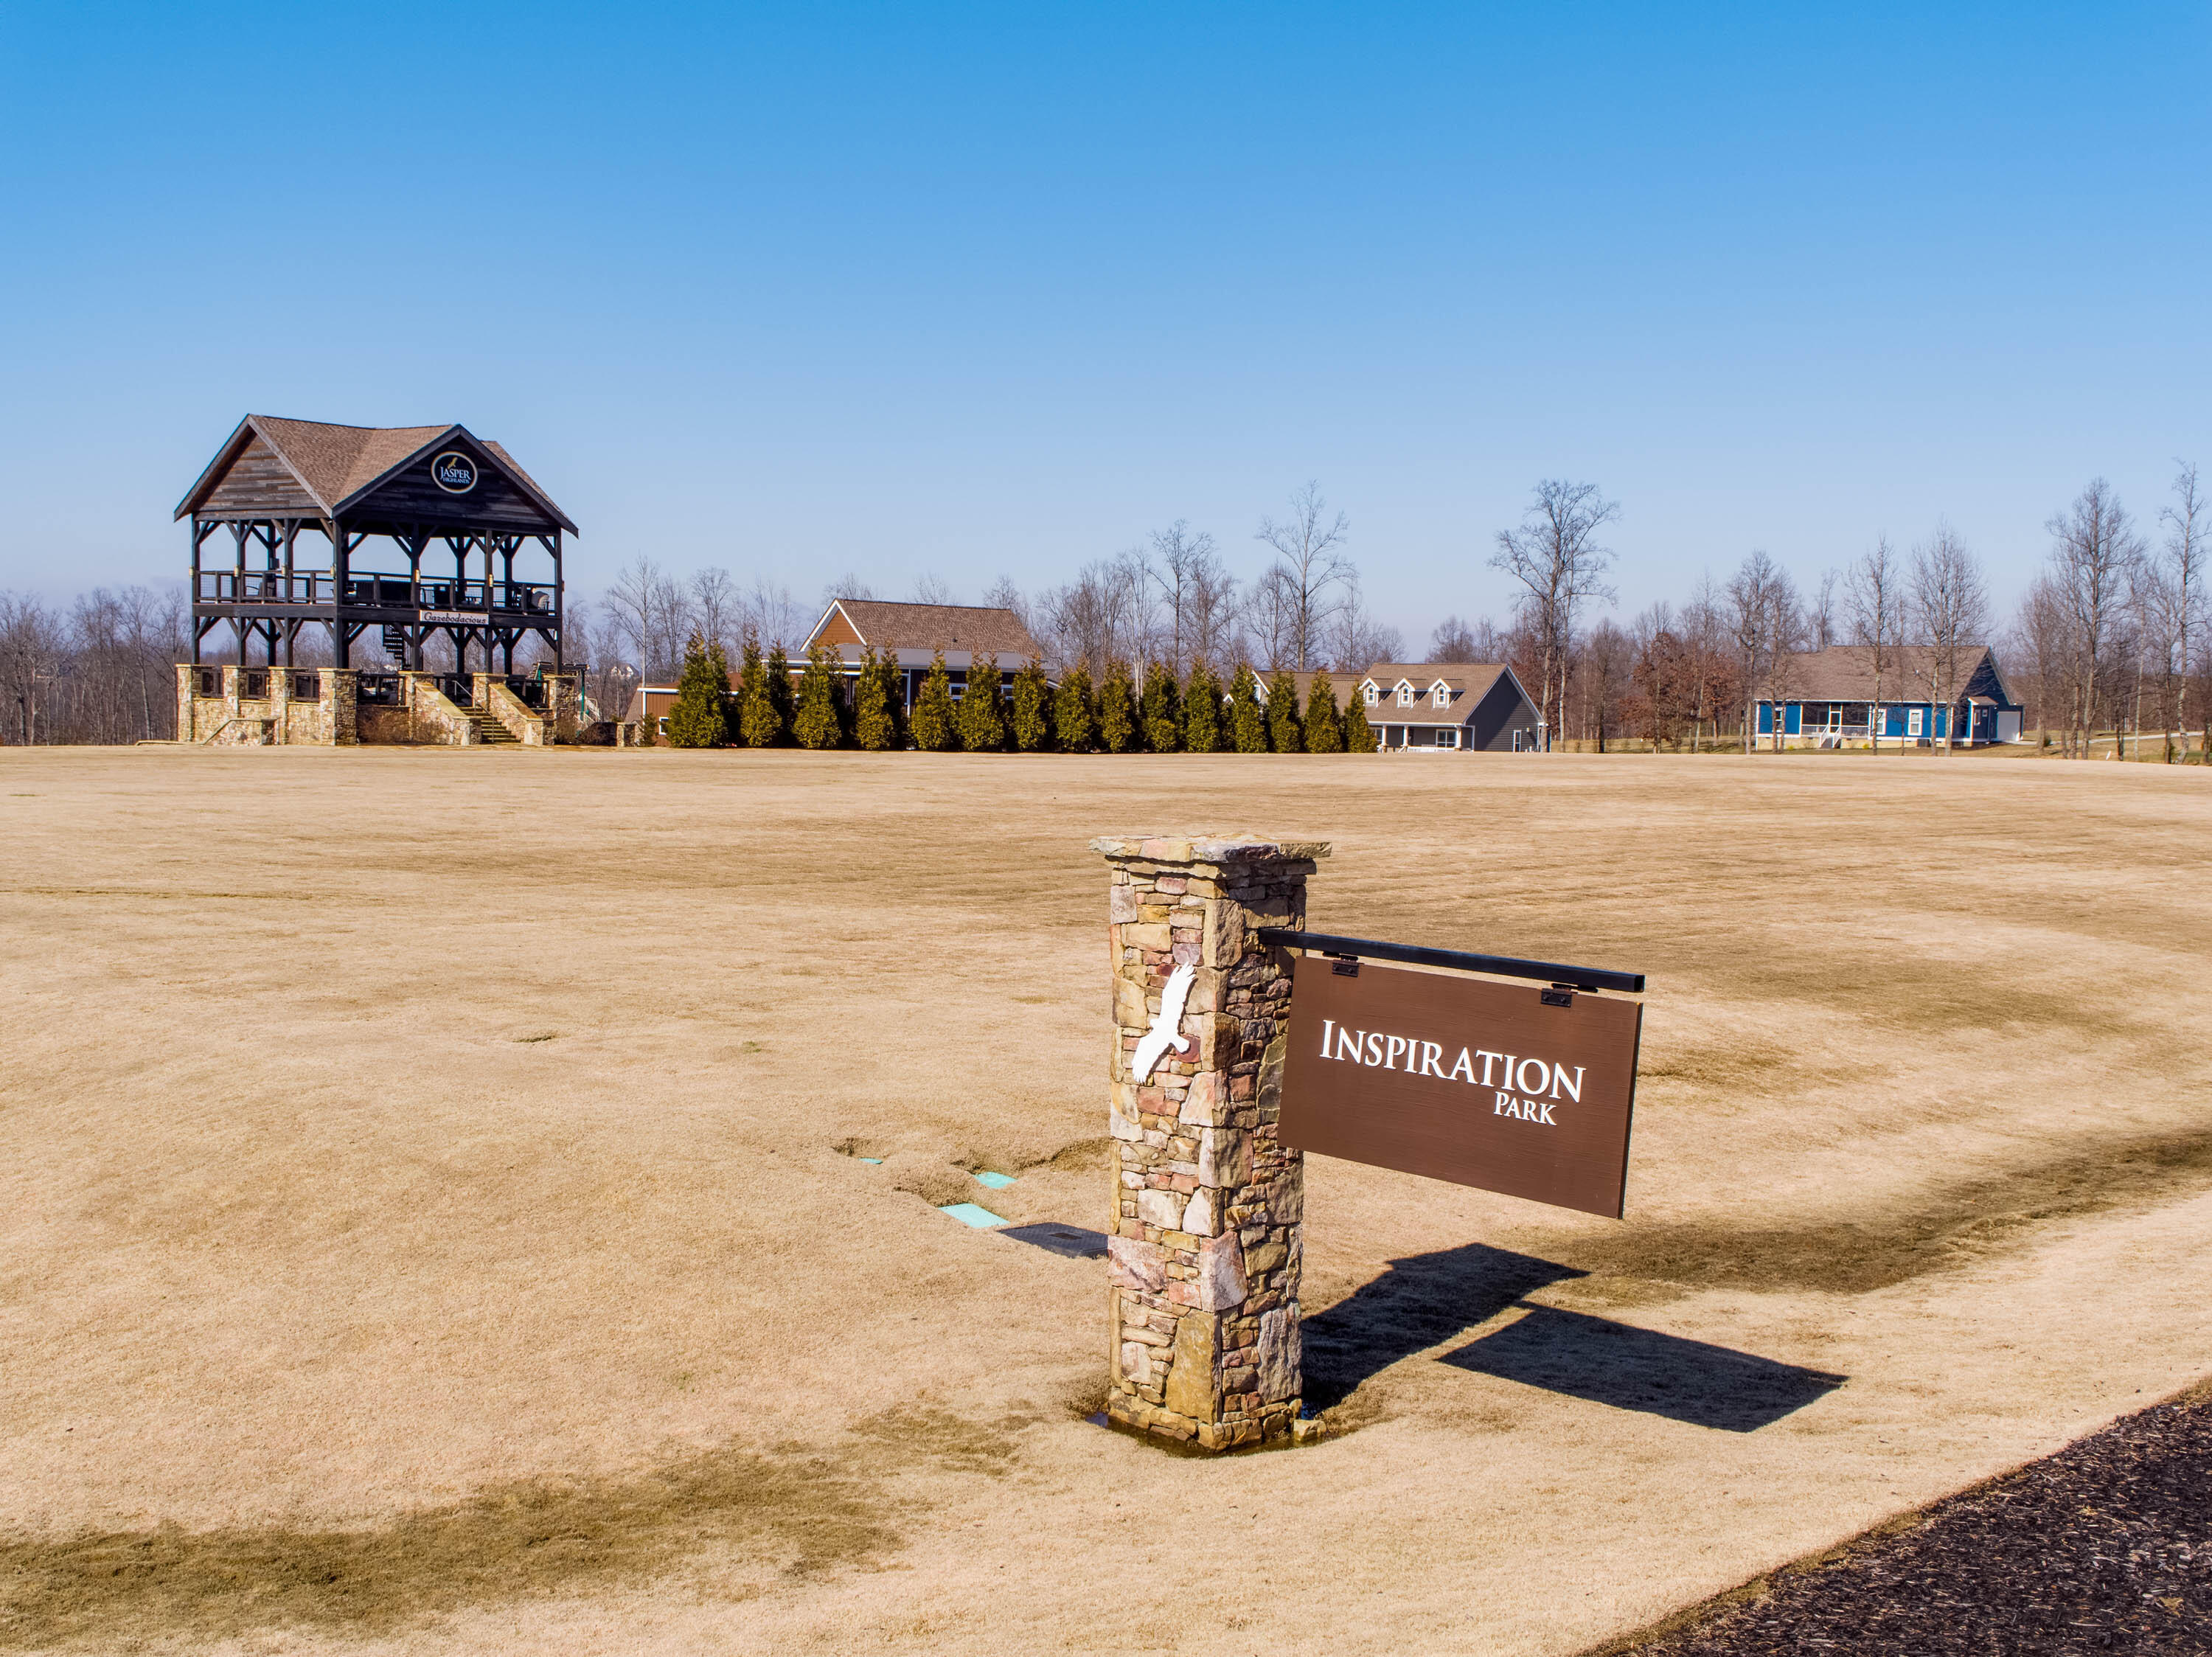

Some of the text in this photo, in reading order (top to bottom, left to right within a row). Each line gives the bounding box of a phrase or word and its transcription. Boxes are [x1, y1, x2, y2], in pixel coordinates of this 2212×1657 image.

[439, 466, 471, 480] JASPER
[424, 611, 486, 624] Gazebodacious
[1319, 1019, 1587, 1103] INSPIRATION
[1493, 1091, 1557, 1126] PARK
